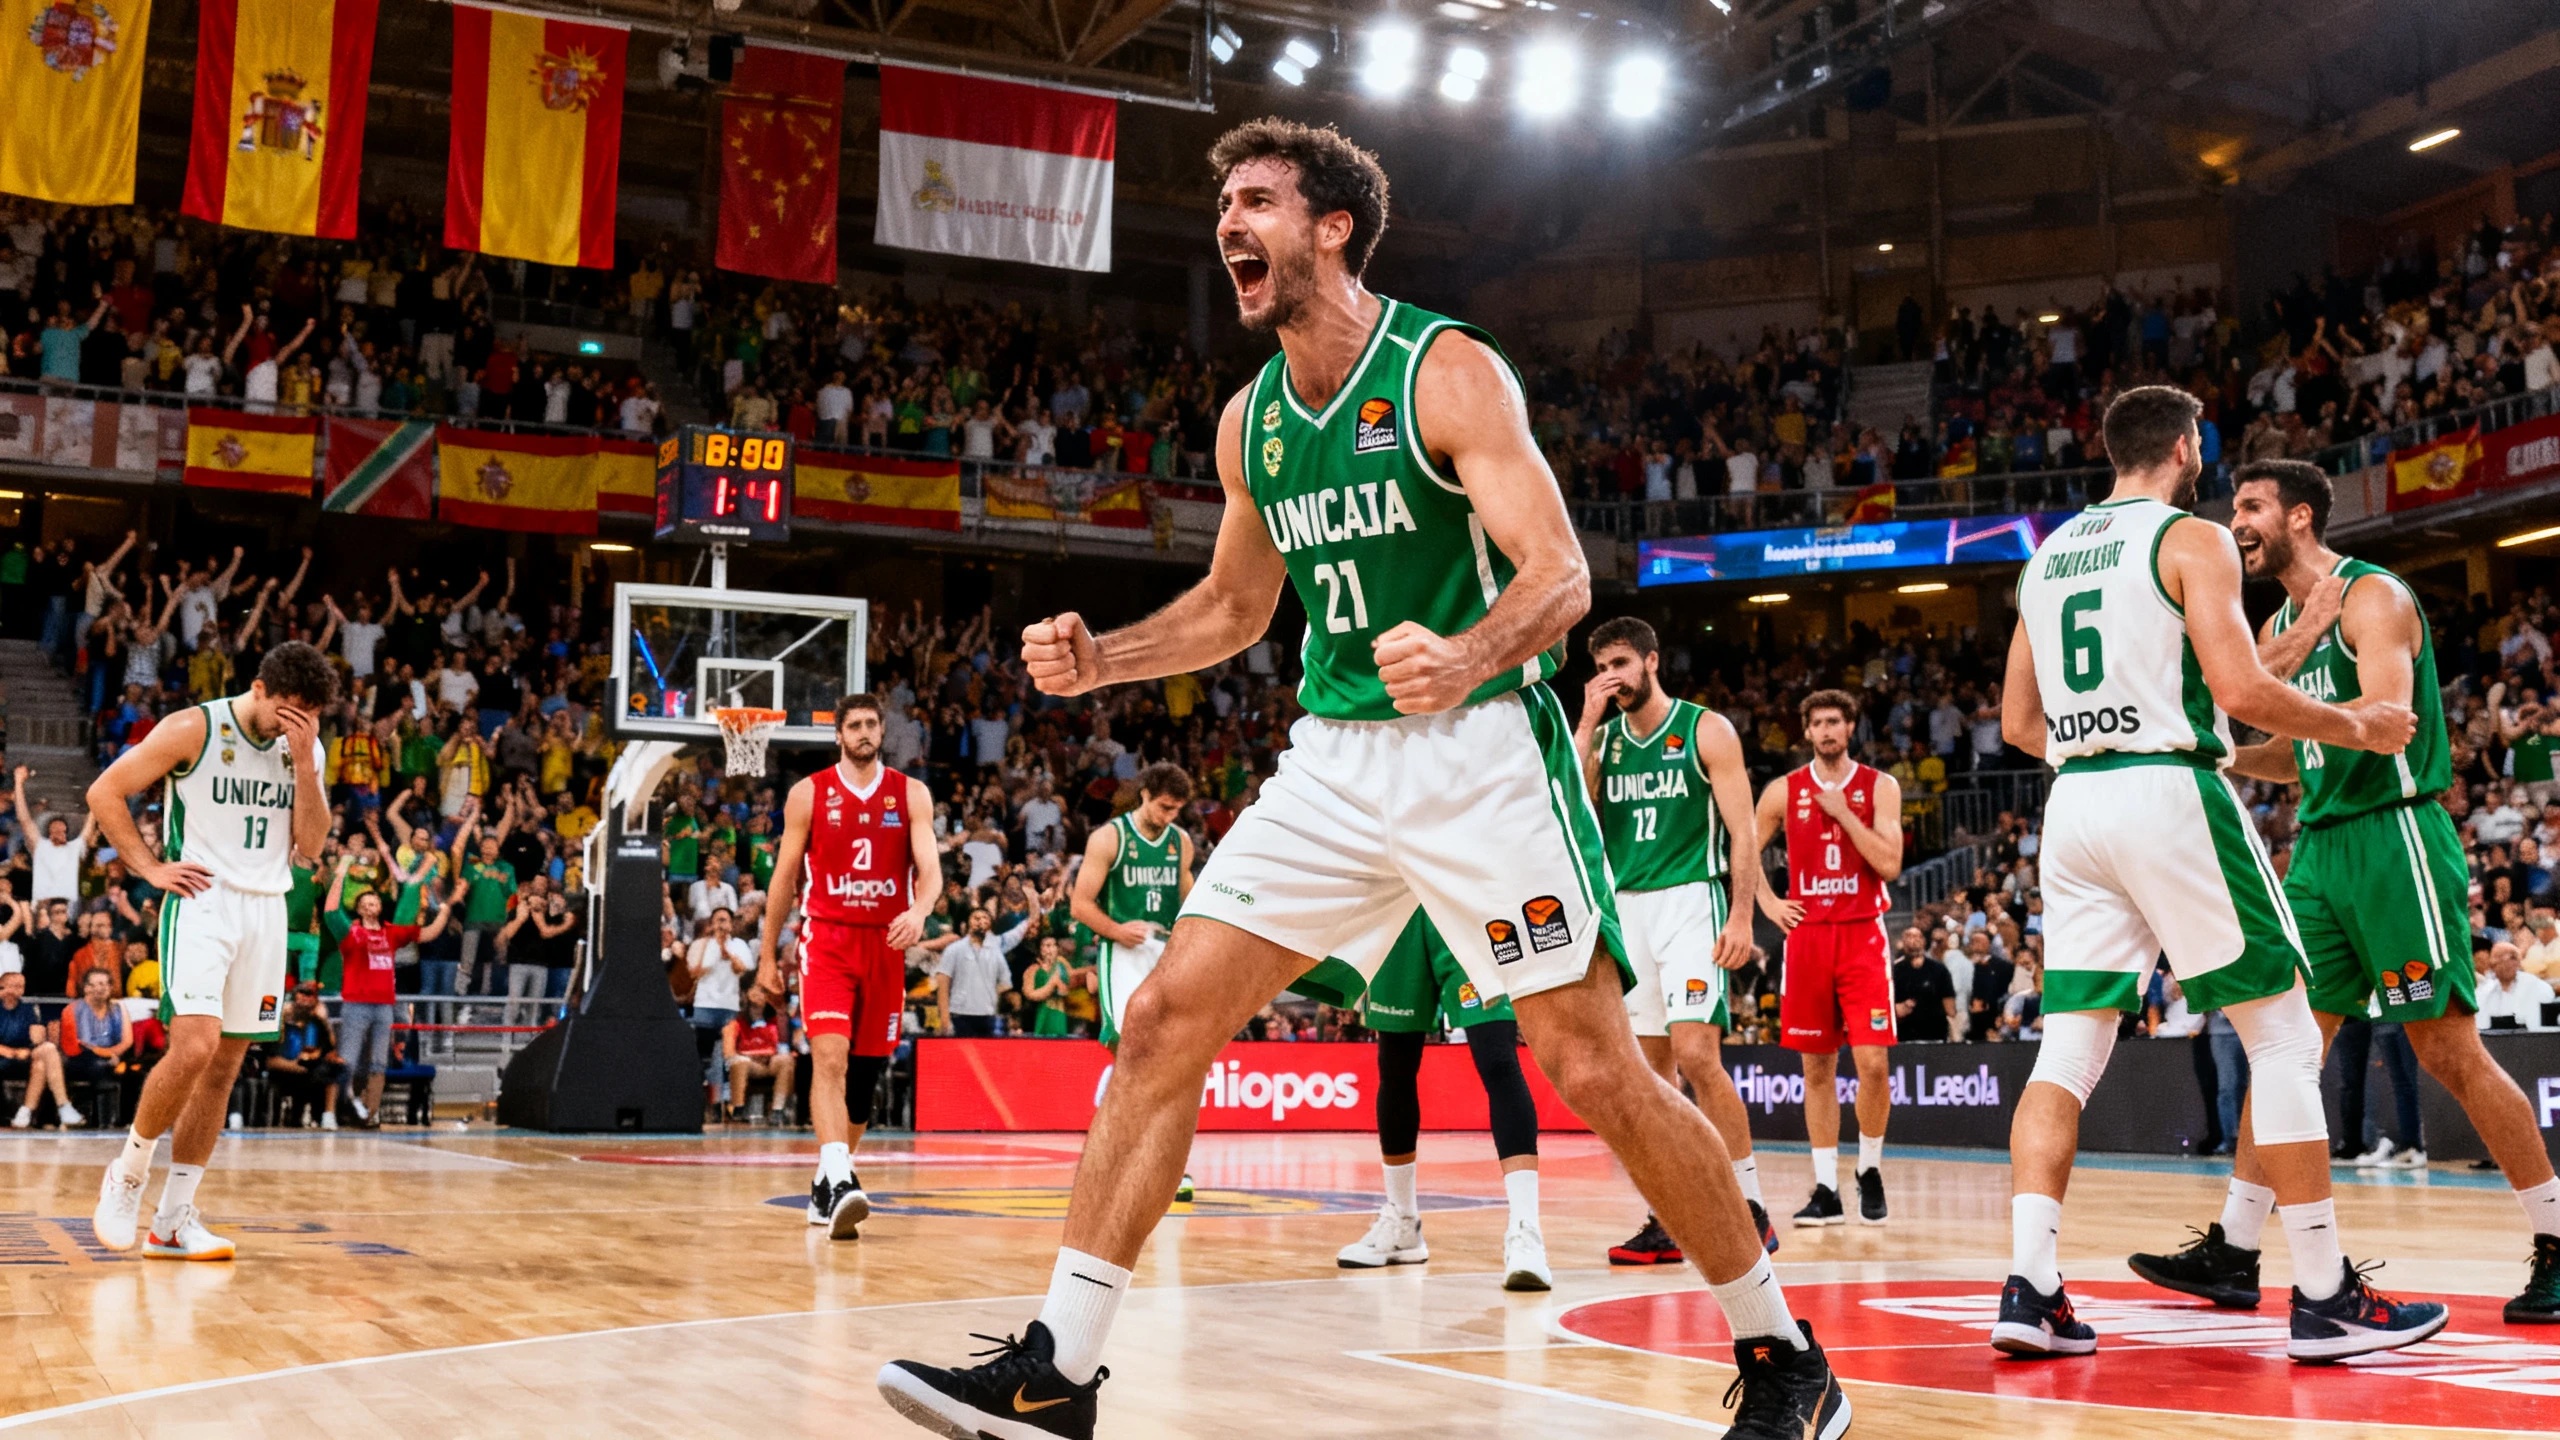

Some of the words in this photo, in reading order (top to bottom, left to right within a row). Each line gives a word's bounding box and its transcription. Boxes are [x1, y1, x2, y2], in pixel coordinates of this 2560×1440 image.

[1314, 559, 1369, 634] 21
[2061, 587, 2104, 694] 6
[1201, 1060, 1359, 1121] Hiopos
